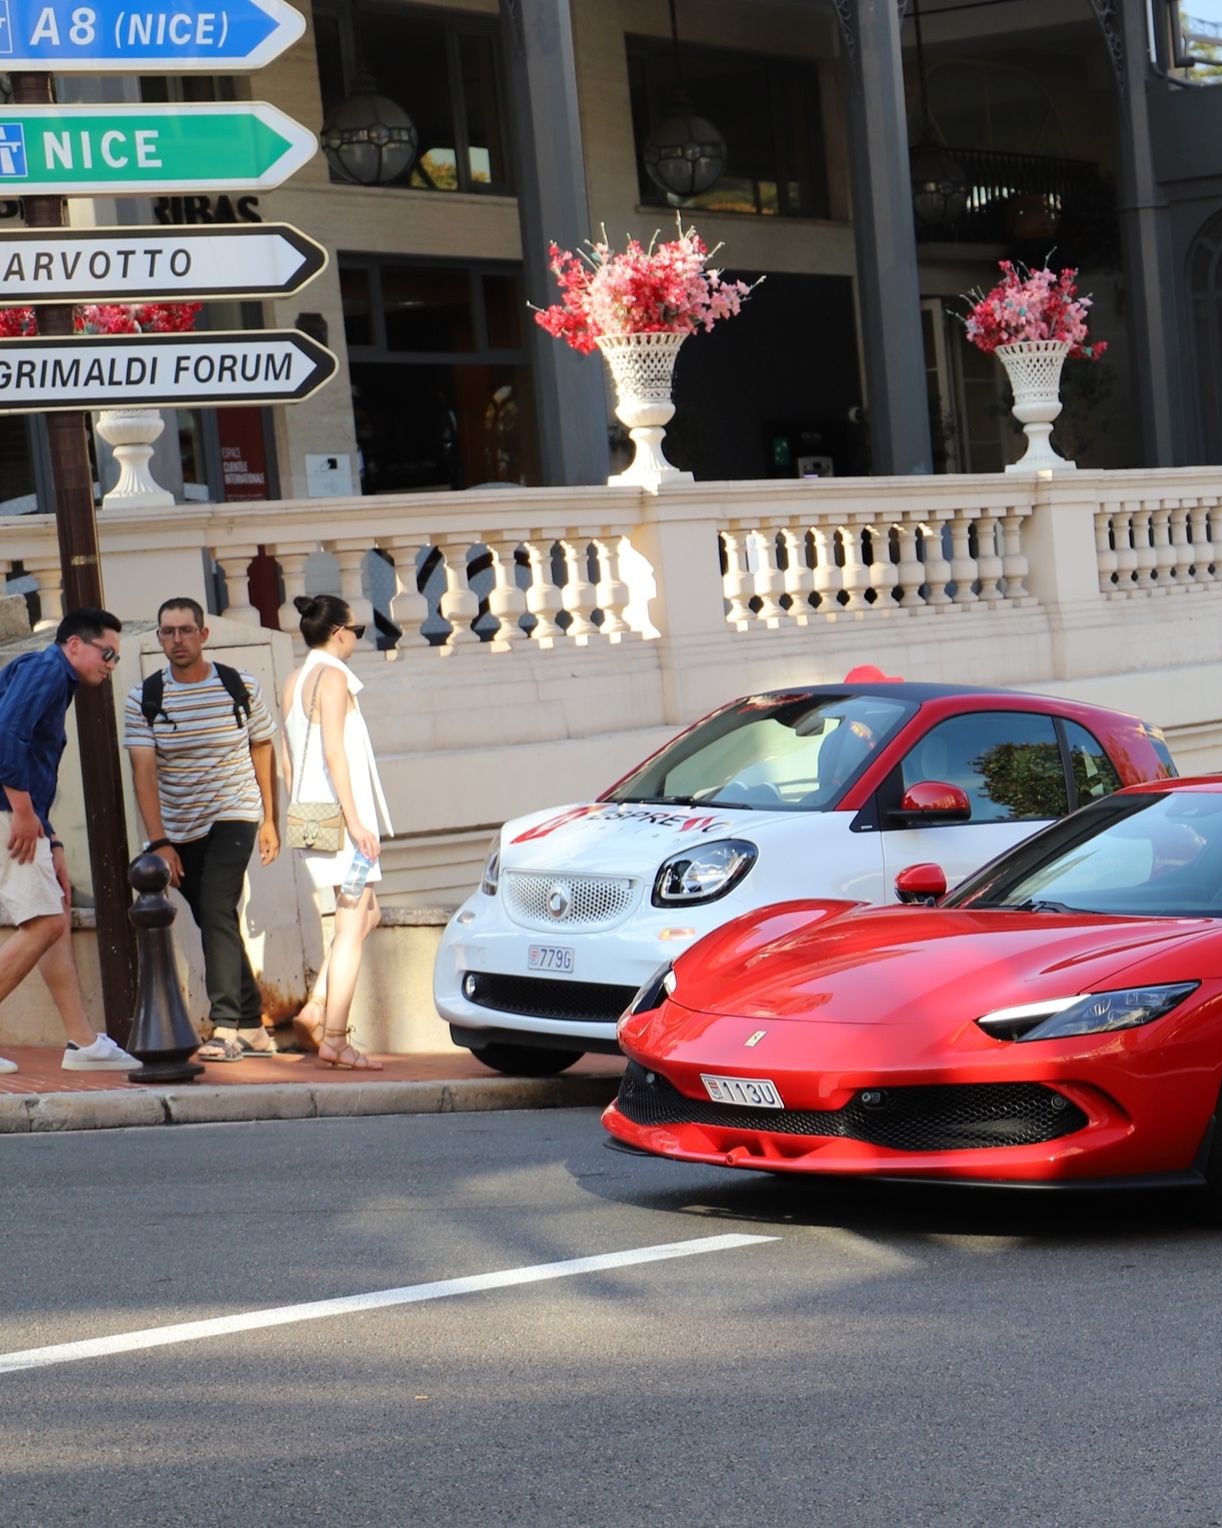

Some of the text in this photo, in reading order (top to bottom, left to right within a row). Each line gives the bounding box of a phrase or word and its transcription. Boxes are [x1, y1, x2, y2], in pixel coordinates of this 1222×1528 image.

[115, 11, 229, 48] (NICE)
[43, 129, 162, 170] NICE
[3, 248, 192, 282] ARVOTTO
[0, 352, 292, 390] GRIMALDI FORUM
[540, 948, 572, 969] 779G
